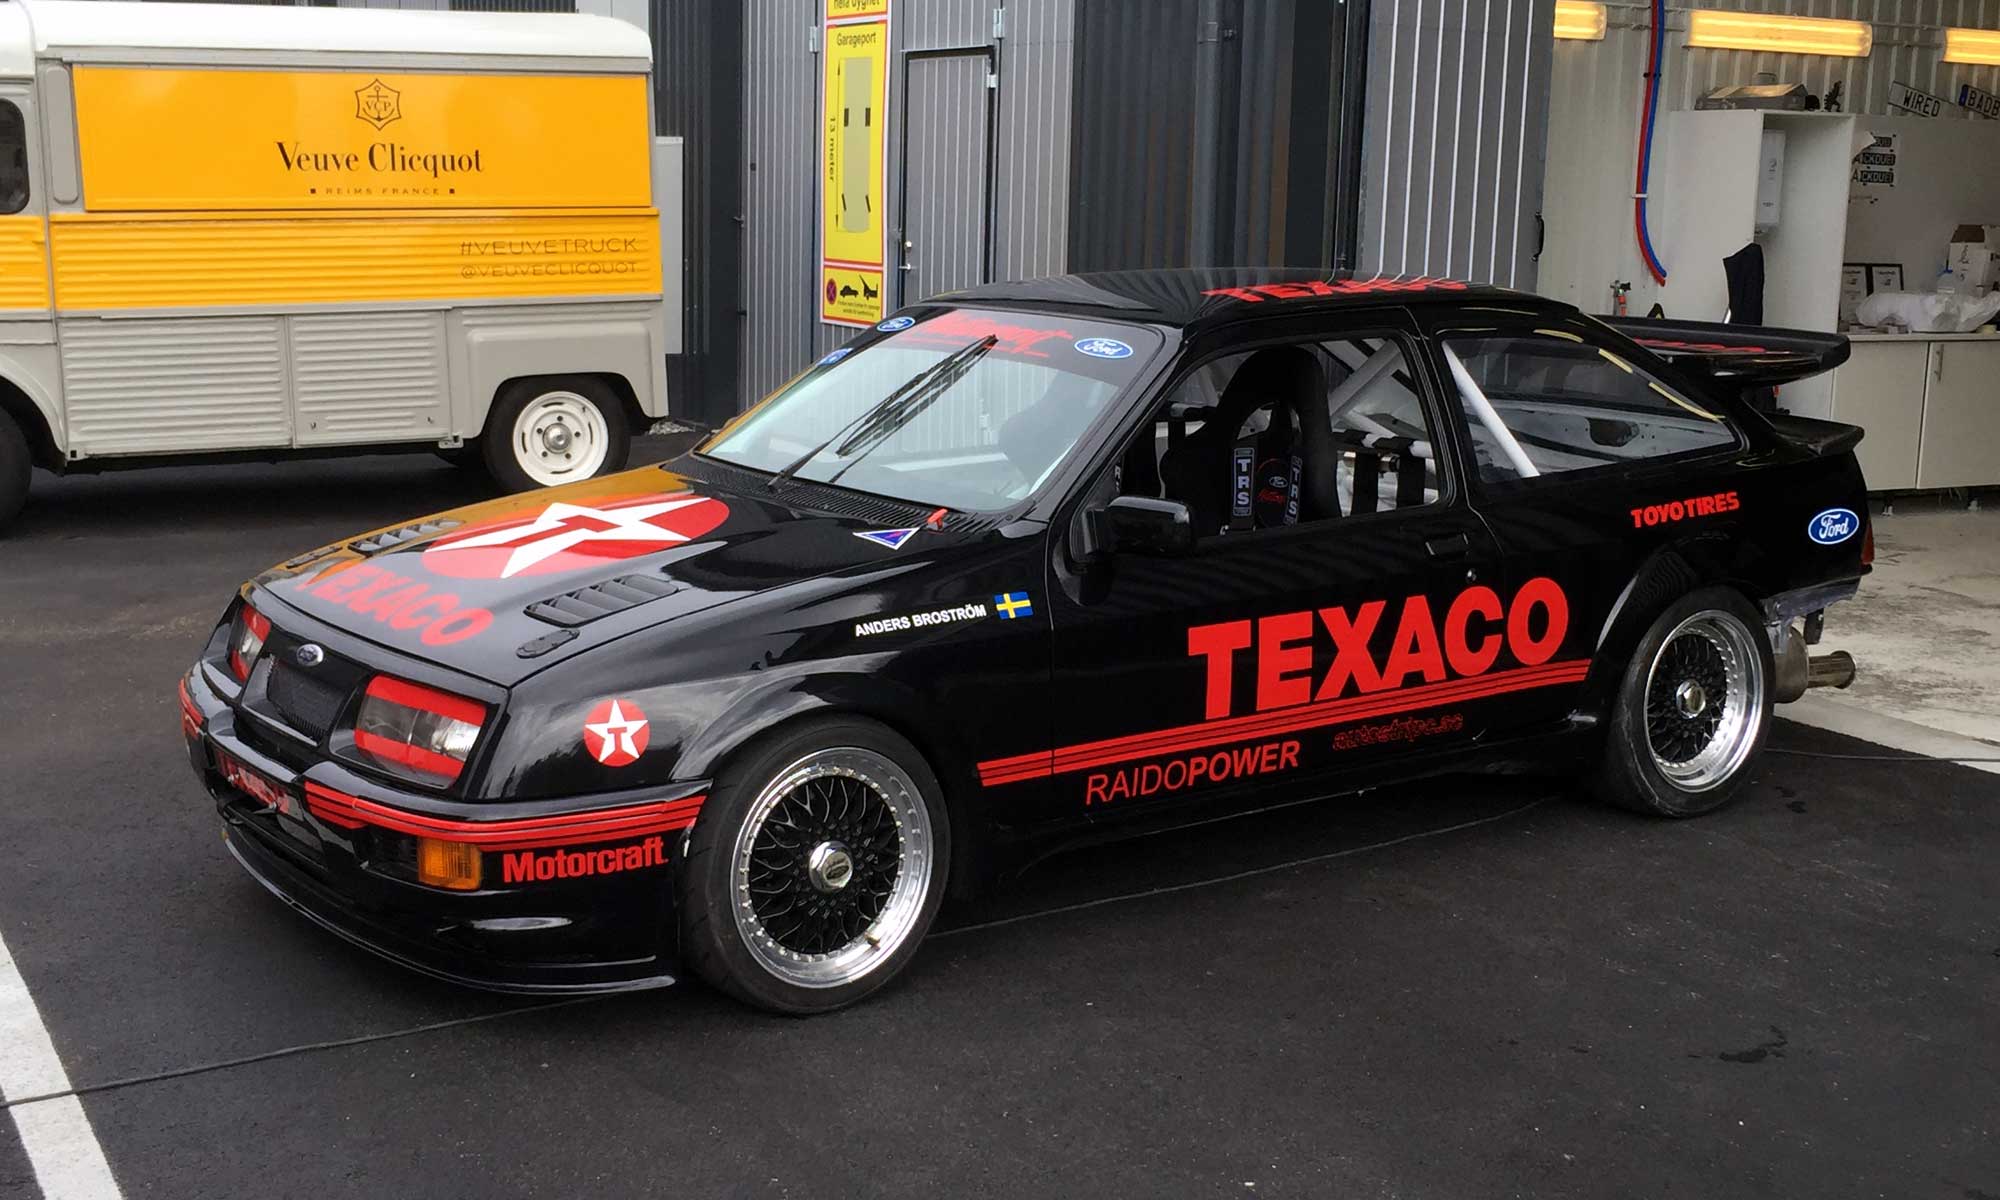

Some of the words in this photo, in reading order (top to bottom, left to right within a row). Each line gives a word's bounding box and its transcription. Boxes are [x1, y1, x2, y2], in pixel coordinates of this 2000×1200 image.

[836, 32, 877, 48] Garageport
[365, 100, 391, 112] VCP
[1903, 89, 1941, 118] WIRED
[829, 118, 836, 133] 13
[275, 141, 359, 172] Veuve
[368, 142, 485, 178] Clicquot
[461, 237, 637, 256] #VEUVETRUCK
[461, 261, 637, 279] @VEUVECLICQUOT
[1237, 458, 1251, 505] TRS
[1288, 466, 1301, 515] TRS
[1818, 514, 1849, 539] Ford
[296, 560, 494, 646] TEXACO
[855, 616, 911, 637] ANDERS
[912, 604, 987, 628] BROSTRÖM
[1188, 577, 1569, 720] TEXACO
[1086, 741, 1300, 805] RAIDOPOWER
